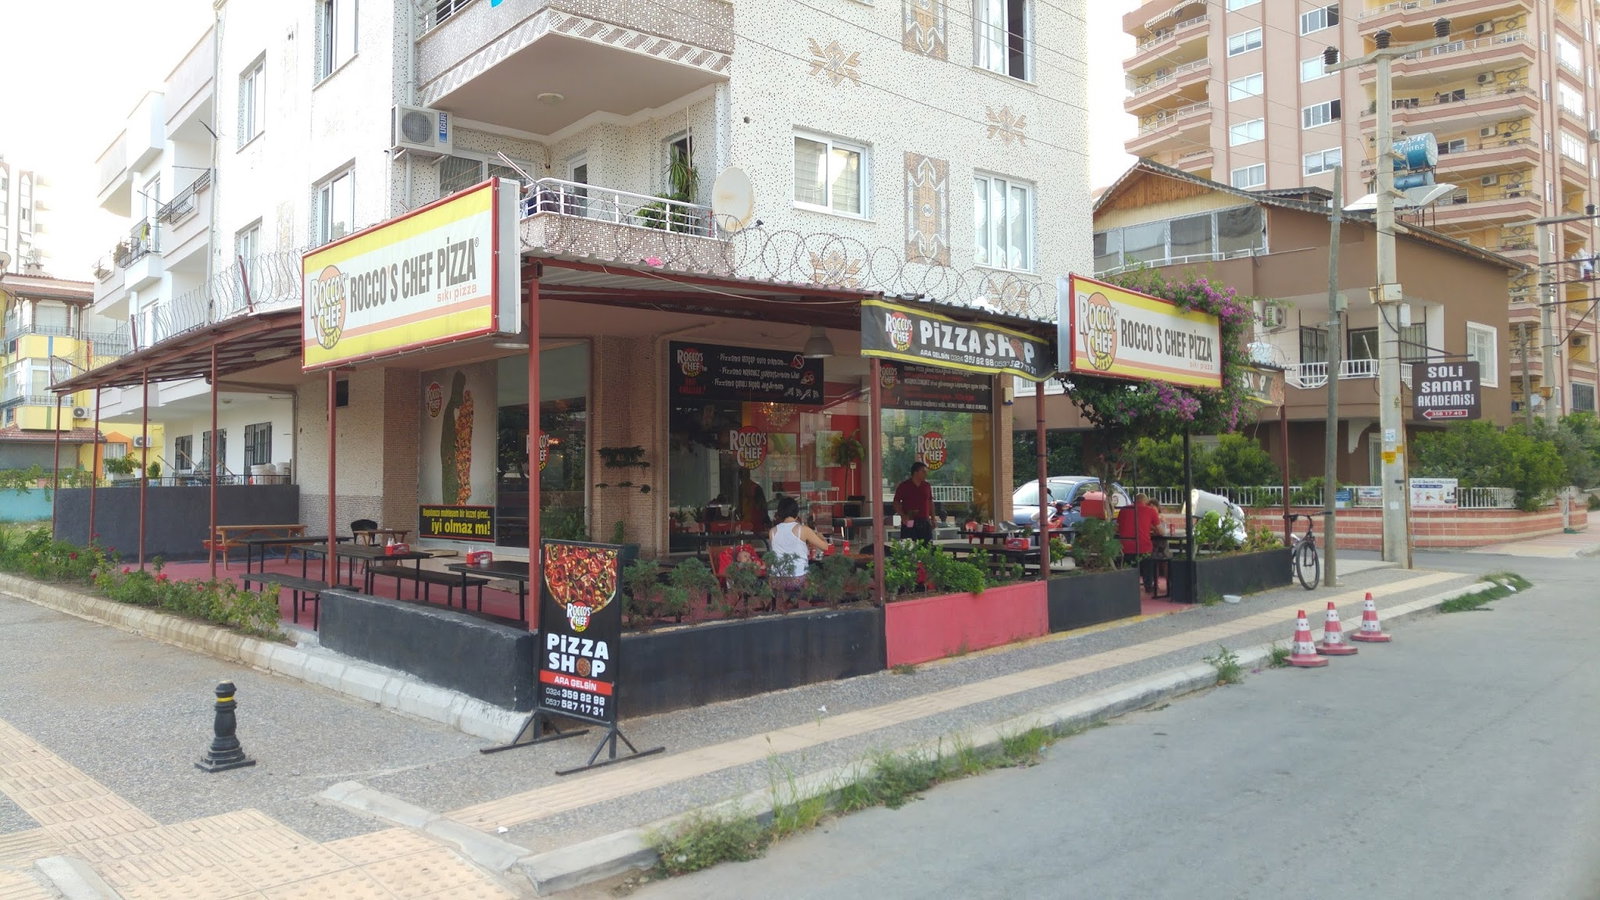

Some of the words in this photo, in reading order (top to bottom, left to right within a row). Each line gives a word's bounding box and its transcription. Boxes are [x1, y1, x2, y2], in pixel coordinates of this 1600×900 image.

[350, 263, 398, 313] ROCCO'S
[401, 251, 433, 299] CHEF
[310, 272, 347, 319] ROCCO'S
[453, 284, 477, 301] pizza
[318, 303, 342, 345] CHEF
[885, 312, 913, 332] ROCCO'S
[1079, 295, 1117, 335] ROCCO'S
[891, 330, 909, 348] CHEF
[1088, 328, 1112, 366] CHEF
[1120, 318, 1162, 354] ROCCO'S
[1164, 328, 1186, 358] CHEF
[677, 349, 703, 364] ROCCO'S
[681, 361, 701, 375] CHEF
[729, 429, 767, 451] ROCCO'S
[918, 436, 947, 453] ROCCO'S
[736, 447, 762, 467] CHEF
[923, 450, 944, 467] CHEF
[431, 518, 442, 535] iyi
[444, 519, 473, 534] olmaz
[475, 520, 491, 535] mı!
[566, 603, 591, 618] ROCCO'S
[570, 616, 587, 630] CHEF
[554, 675, 569, 686] ARA
[545, 687, 561, 696] 0324
[561, 689, 578, 700] 359
[580, 693, 592, 703] 82
[545, 697, 561, 707] 0537
[561, 699, 578, 711] 527
[580, 703, 591, 714] 17
[592, 706, 604, 717] 31
